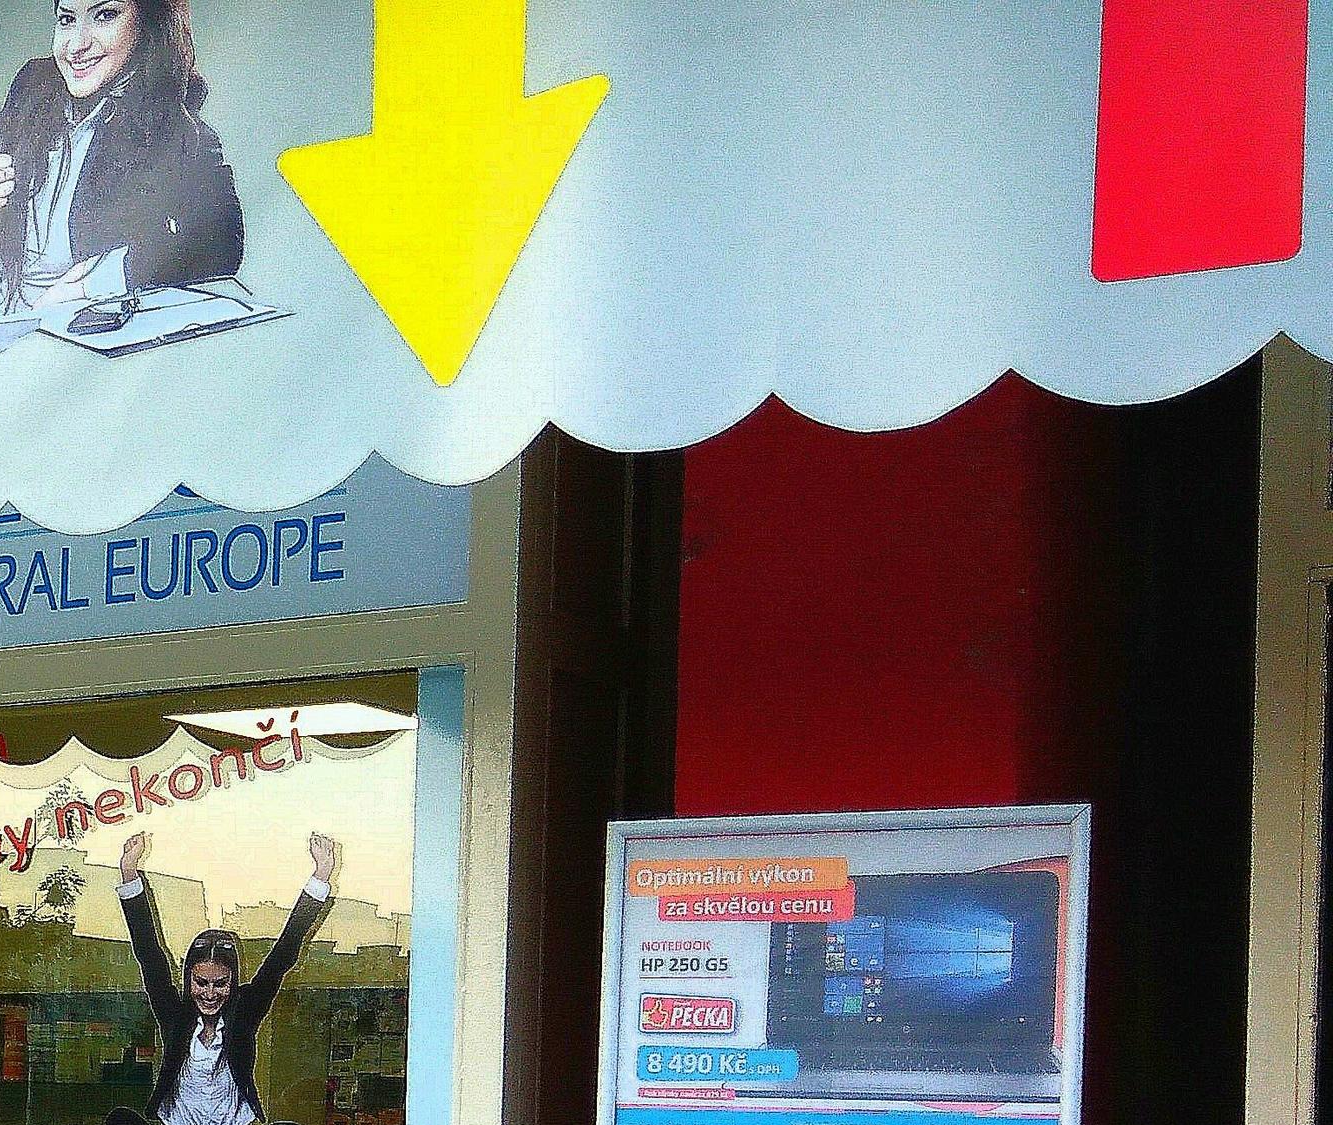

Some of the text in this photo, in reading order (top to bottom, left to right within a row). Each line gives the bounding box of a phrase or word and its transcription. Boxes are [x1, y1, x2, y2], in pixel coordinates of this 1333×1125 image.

[104, 512, 346, 604] EUROPE
[54, 710, 304, 843] nekončí
[636, 864, 814, 889] Optimální výkon
[665, 897, 833, 916] za skvělou cenu
[641, 940, 712, 951] NOTEBOOK
[641, 957, 729, 972] HP 250 G5
[670, 1006, 730, 1027] PECKA
[646, 1054, 663, 1074] 8
[667, 1053, 713, 1074] 490
[719, 1053, 748, 1074] Kč
